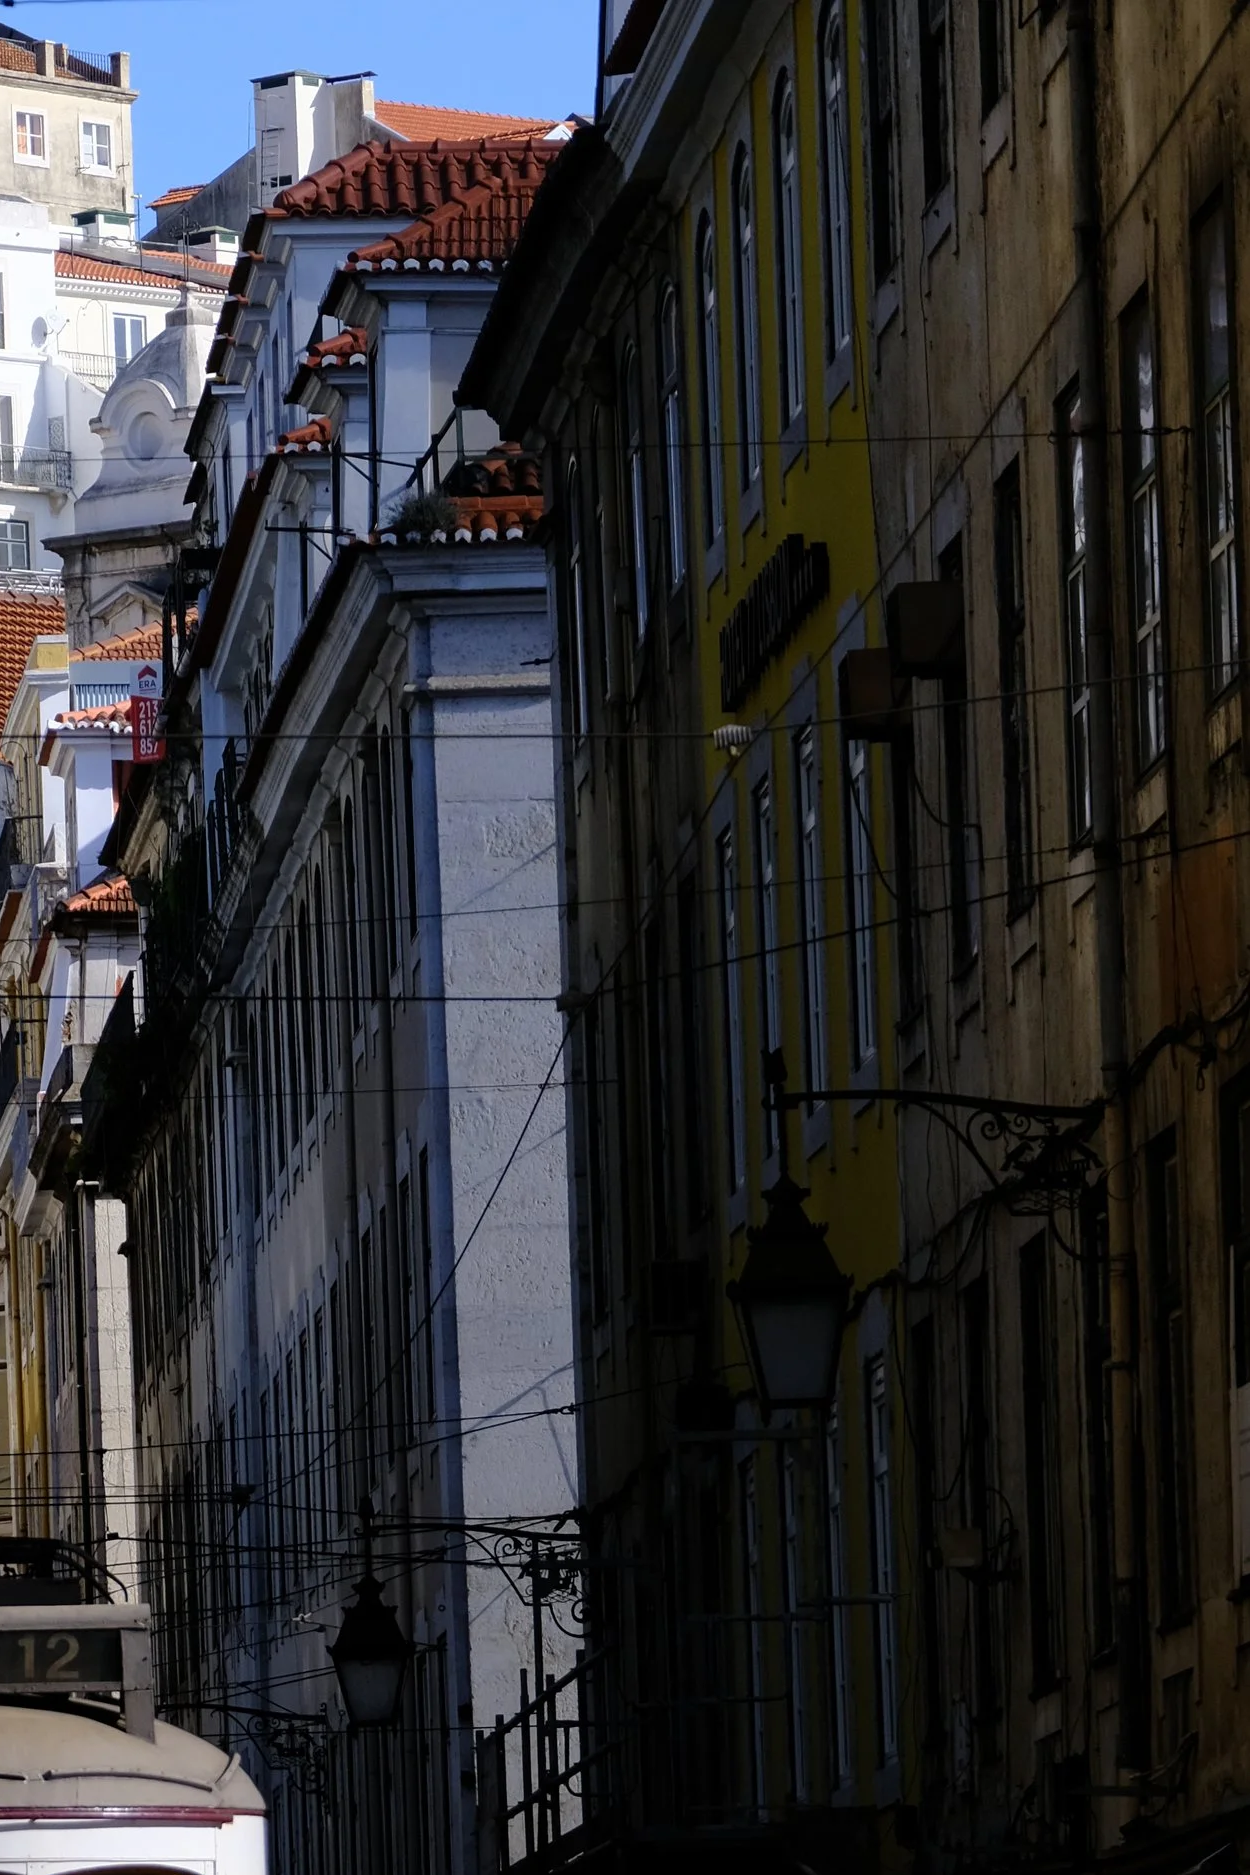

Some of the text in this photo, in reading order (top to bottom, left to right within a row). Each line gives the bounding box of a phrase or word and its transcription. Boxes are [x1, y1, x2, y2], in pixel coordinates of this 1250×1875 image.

[139, 679, 156, 689] ERA
[139, 701, 158, 719] 213
[18, 1632, 80, 1679] 12
